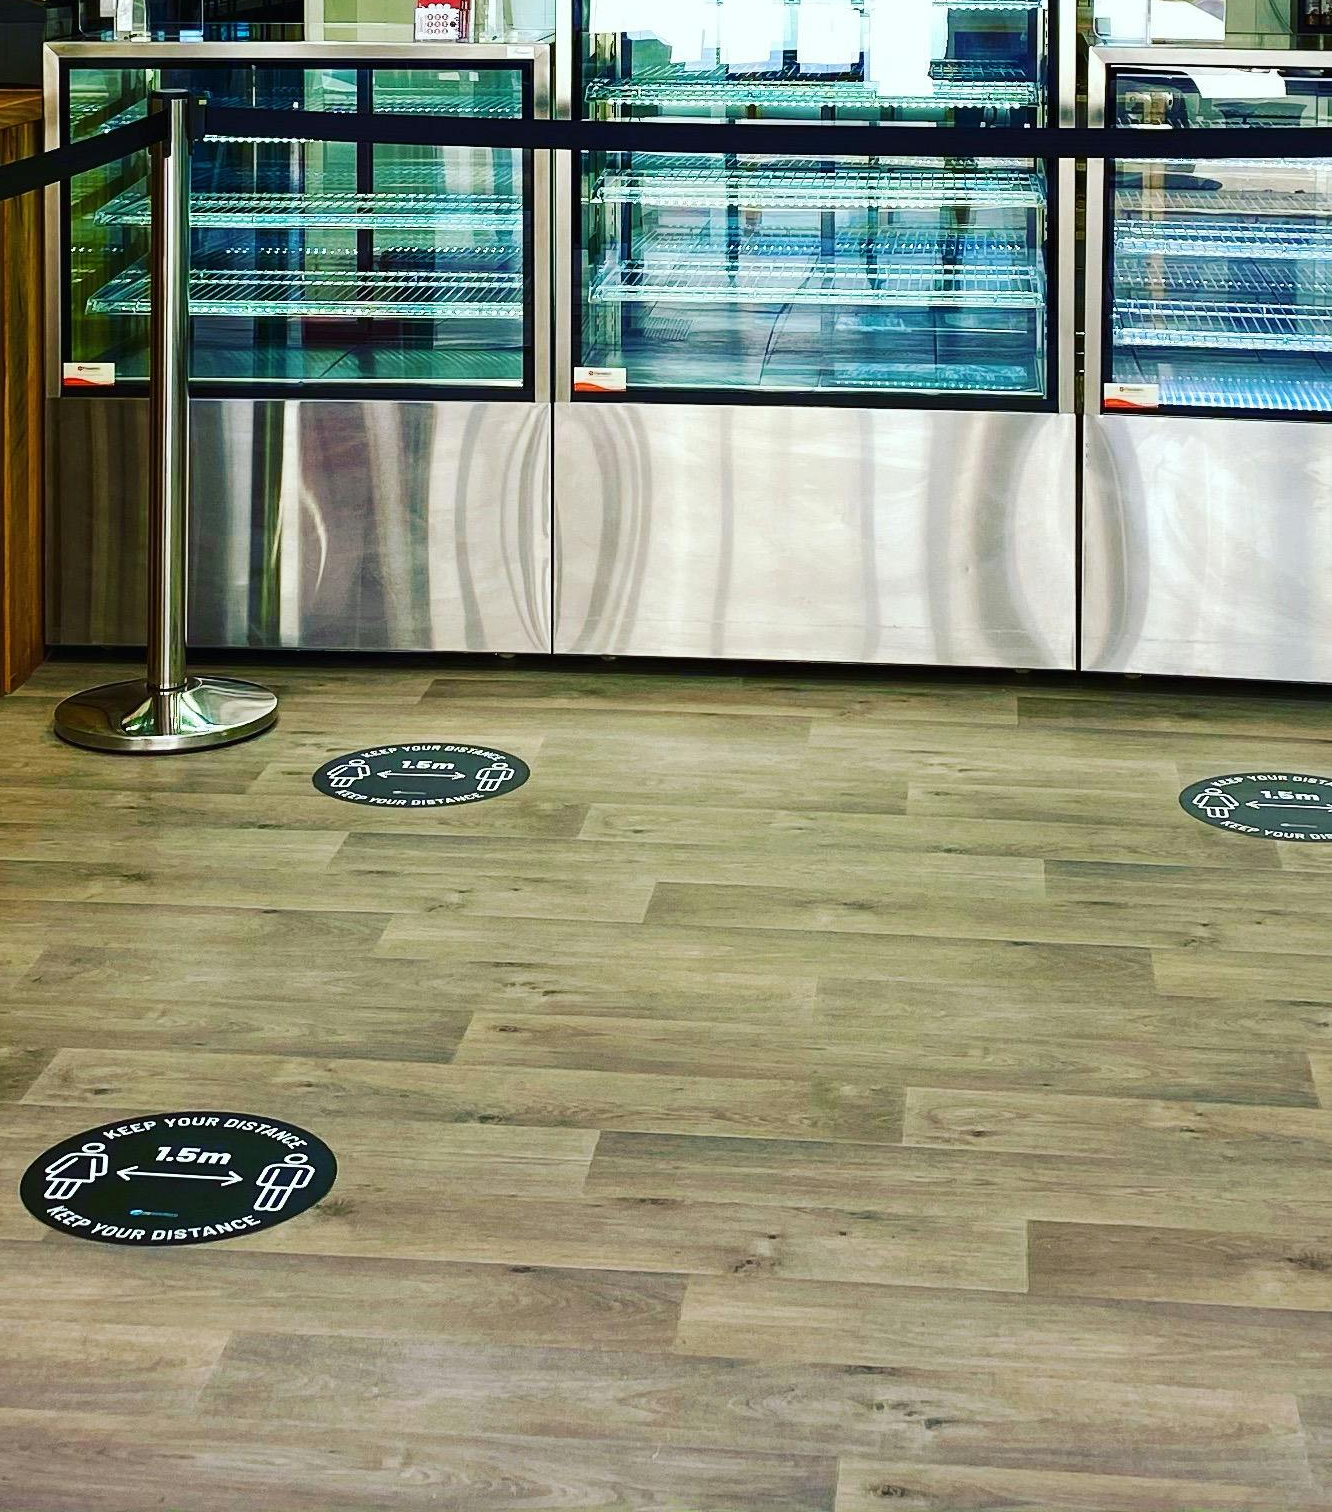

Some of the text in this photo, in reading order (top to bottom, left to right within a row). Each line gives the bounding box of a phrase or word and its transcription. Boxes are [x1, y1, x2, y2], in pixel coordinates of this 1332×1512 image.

[361, 747, 398, 759] KEEP
[444, 745, 507, 762] DISTANCE
[401, 760, 455, 770] 1.5m
[1210, 776, 1244, 788] KEEP
[1246, 774, 1288, 782] YOUR
[335, 789, 368, 801] KEEP
[369, 795, 407, 806] YOUR
[411, 792, 485, 806] DISTANCE
[1260, 790, 1320, 801] 1.5m
[1220, 820, 1260, 833] KEEP
[1264, 829, 1305, 840] YOUR
[103, 1116, 308, 1150] KEEP YOUR DISTANCE
[155, 1146, 232, 1165] 1.5m
[47, 1204, 261, 1241] KEEP YOUR DISTANCE
